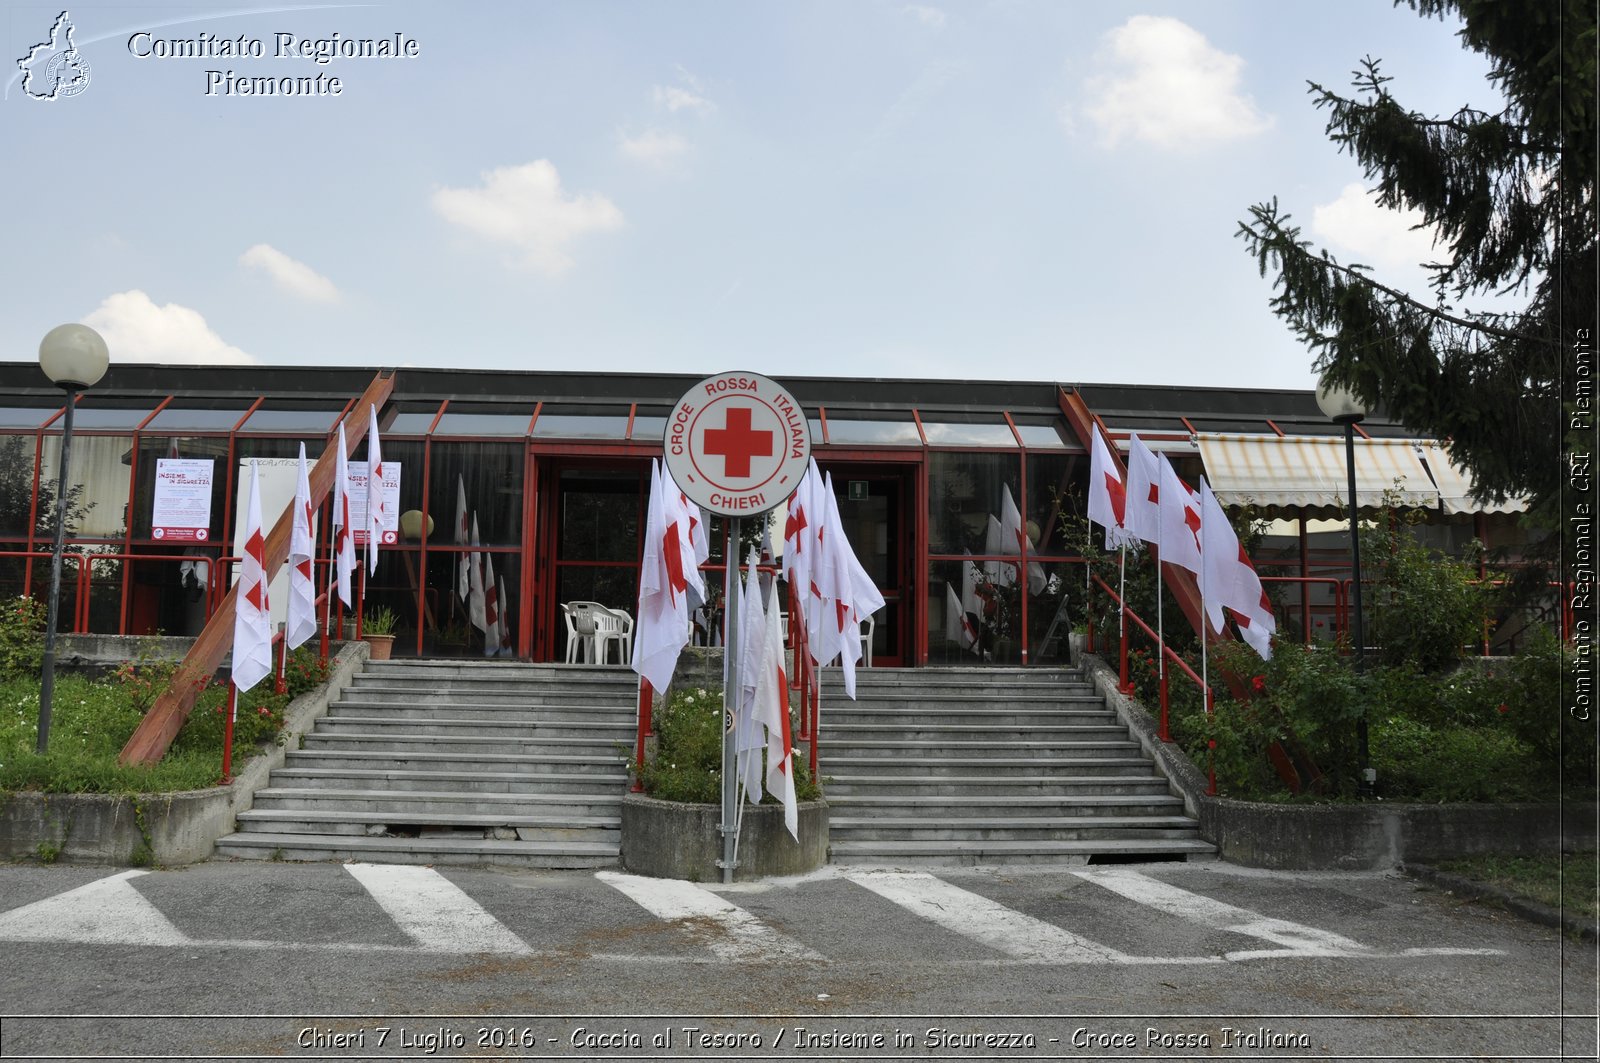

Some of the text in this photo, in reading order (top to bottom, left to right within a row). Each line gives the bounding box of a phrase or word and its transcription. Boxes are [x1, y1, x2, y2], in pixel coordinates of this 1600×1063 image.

[671, 377, 804, 459] CROCE ROSSA ITALIANA
[710, 493, 766, 509] CHIERI
